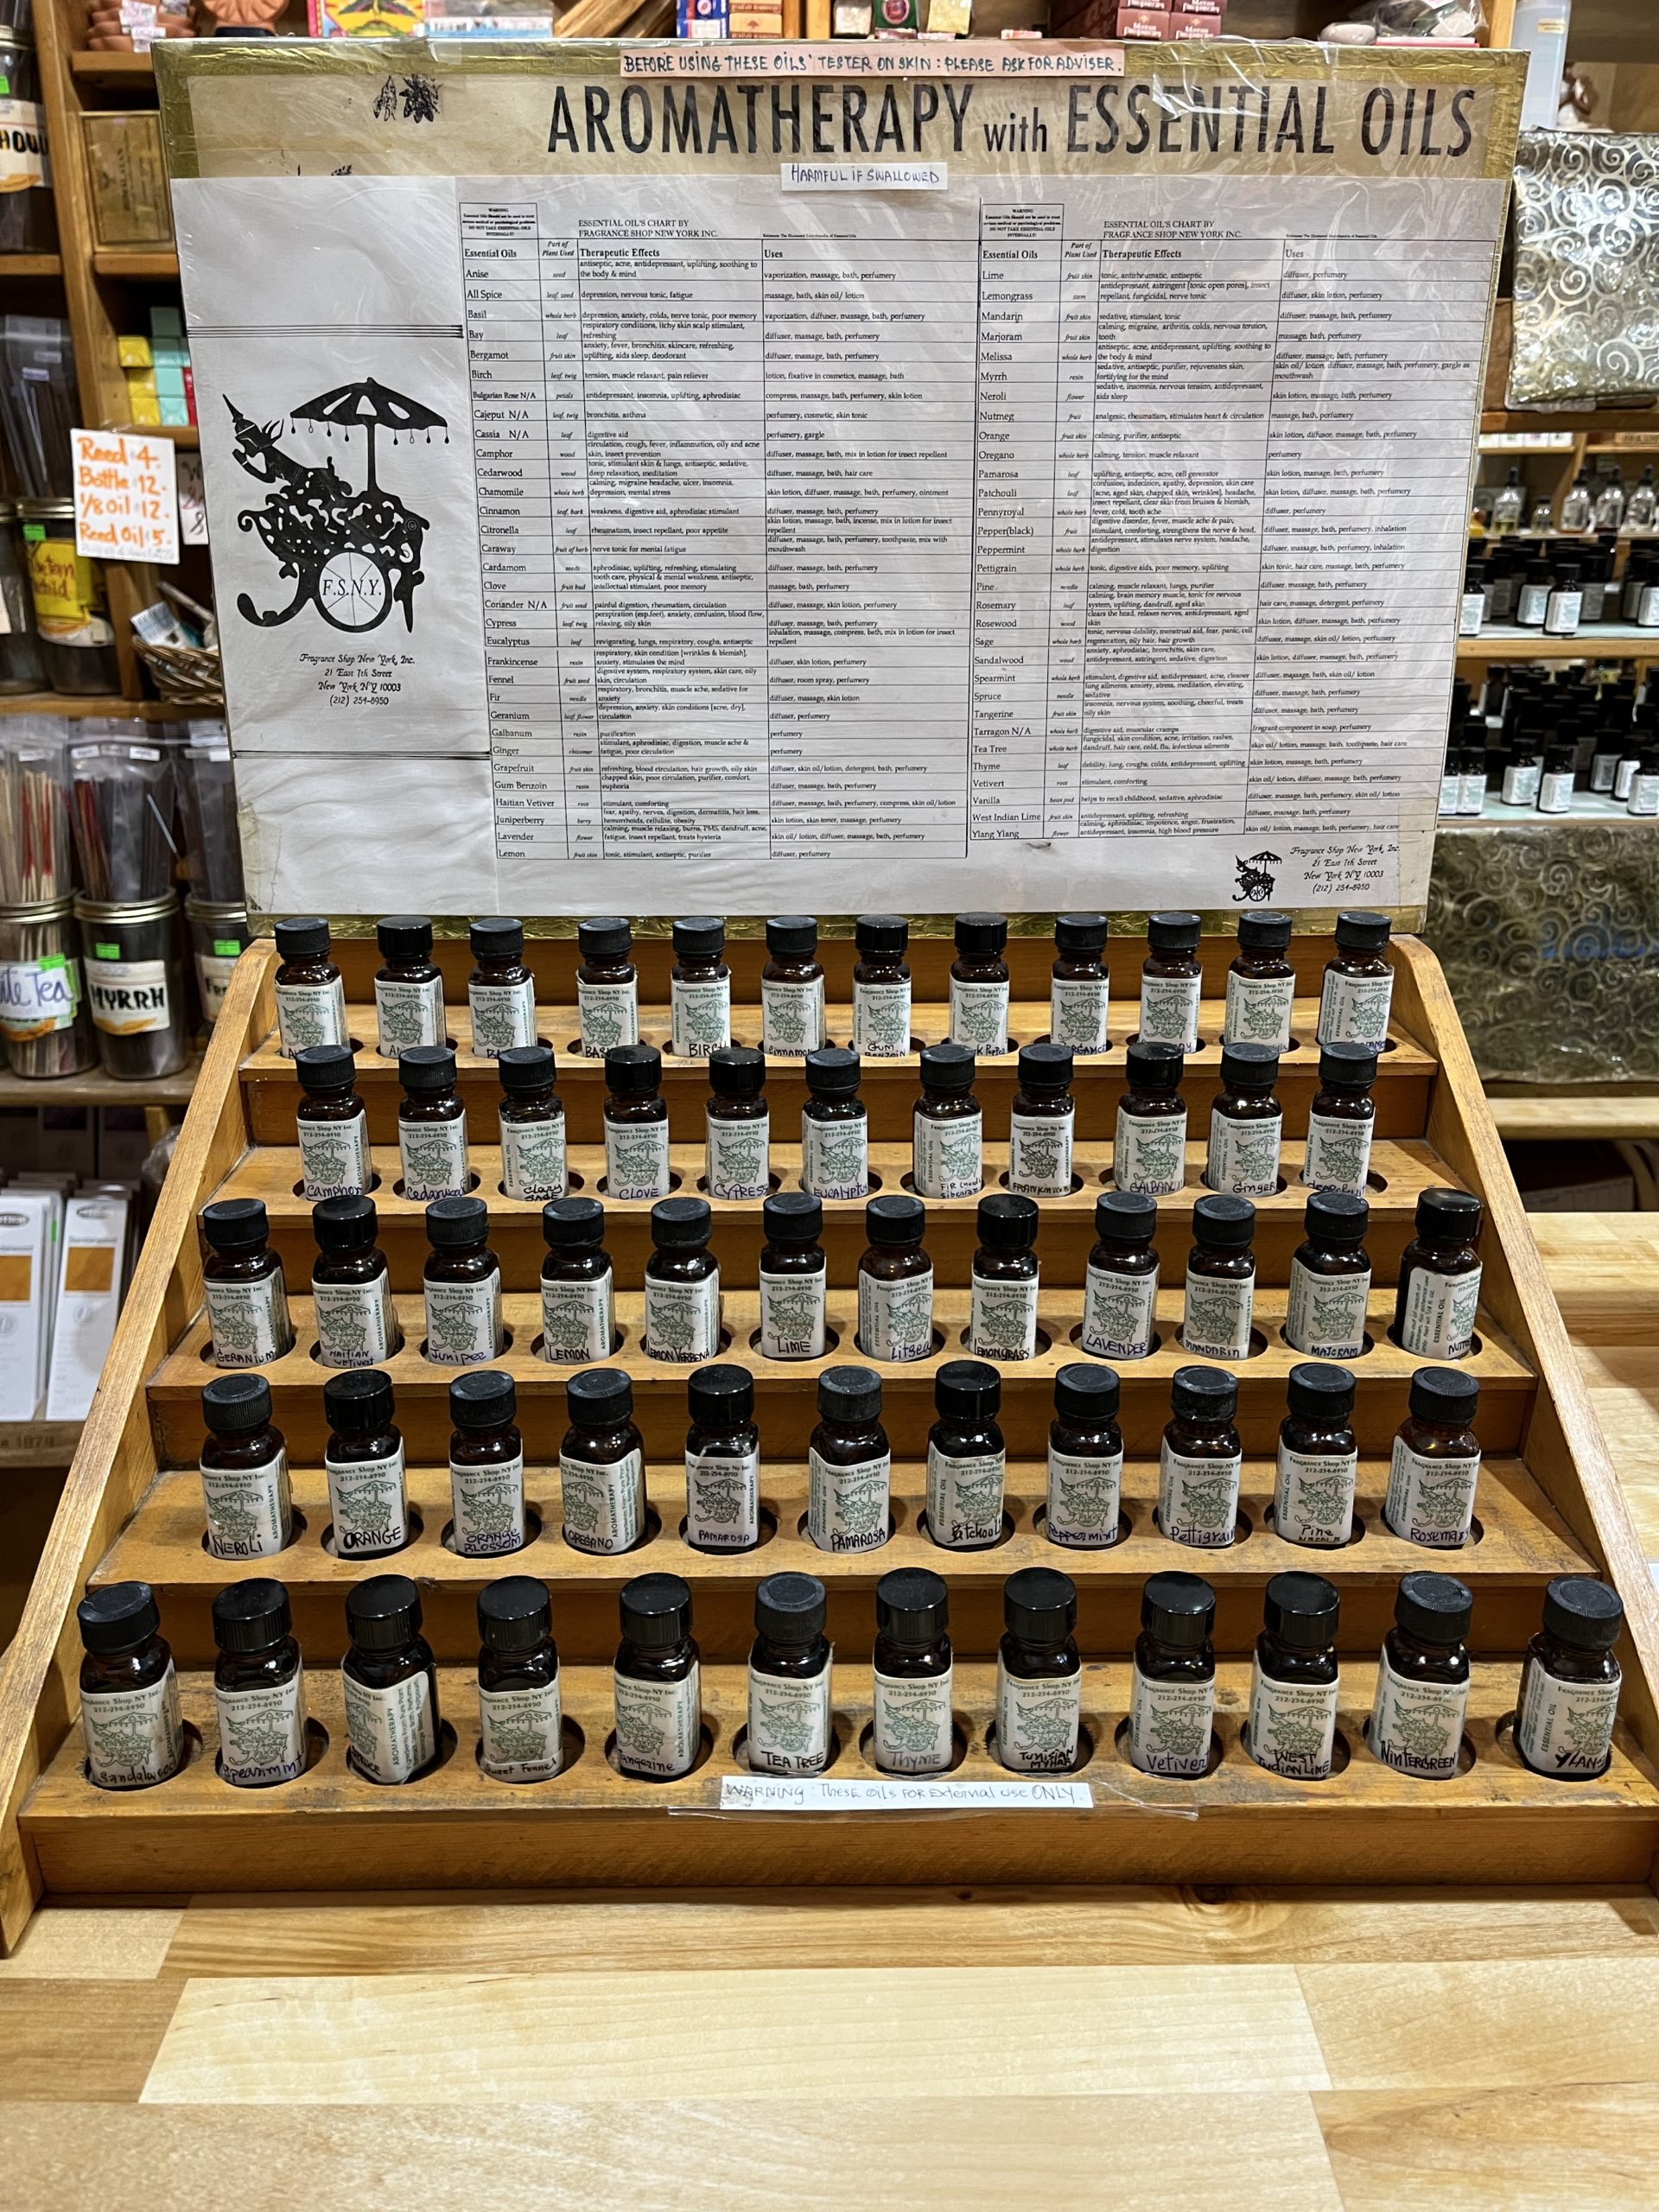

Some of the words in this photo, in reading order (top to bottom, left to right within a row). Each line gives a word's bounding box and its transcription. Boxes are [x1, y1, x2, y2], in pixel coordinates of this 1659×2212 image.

[624, 54, 675, 73] BEFORE
[725, 56, 768, 71] THESE
[818, 56, 871, 72] TESTER
[877, 57, 894, 70] ON
[944, 57, 994, 72] PLEASE
[1002, 57, 1025, 72] ASK
[1028, 56, 1051, 70] FOR
[548, 84, 972, 153] AROMATHERAPY
[983, 105, 1047, 152] with
[1067, 84, 1334, 154] ESSENTIAL
[1362, 88, 1475, 157] OILS
[791, 164, 848, 183] HARMFUL
[867, 168, 939, 183] SWALLOWED
[465, 249, 499, 257] Essential
[501, 249, 517, 257] Oils
[581, 249, 629, 259] Therapeutic
[632, 249, 660, 257] Effects
[764, 250, 783, 258] Uses
[983, 251, 1020, 259] Essential
[1021, 251, 1038, 259] Oils
[1103, 250, 1151, 259] Therapeutic
[1154, 250, 1182, 258] Effects
[861, 271, 896, 280] perfumery
[983, 271, 1004, 280] Lime
[1313, 270, 1347, 280] perfumery
[467, 290, 479, 299] All
[480, 290, 502, 301] Spice
[670, 290, 693, 301] fatigue
[468, 310, 487, 319] Basil
[470, 351, 508, 361] Bergamot
[982, 353, 1013, 361] Melissa
[982, 373, 1007, 382] Myrrh
[474, 410, 505, 420] Cajeput
[980, 412, 1014, 422] Nutmeg
[979, 432, 1010, 442] Orange
[476, 450, 512, 460] Camphor
[477, 468, 523, 477] Cedarwood
[482, 545, 517, 555] Caraway
[977, 546, 1025, 555] Peppermint
[486, 638, 530, 646] Eucalyptus
[976, 639, 994, 647] Sage
[300, 654, 335, 665] Fragrance
[338, 654, 355, 665] Shop
[359, 654, 375, 663] New
[337, 669, 353, 677] East
[489, 676, 514, 684] Fennel
[975, 674, 1015, 683] Spearmint
[318, 682, 335, 690] New
[340, 682, 358, 693] York
[360, 683, 377, 693] NY
[379, 683, 401, 691] 10003
[330, 694, 350, 707] (212)
[975, 710, 1014, 720] Tangerine
[499, 849, 525, 858] Lemon
[1313, 883, 1332, 894] (212)
[619, 1187, 659, 1199] CLOVE
[1086, 1334, 1147, 1355] LAVENDER
